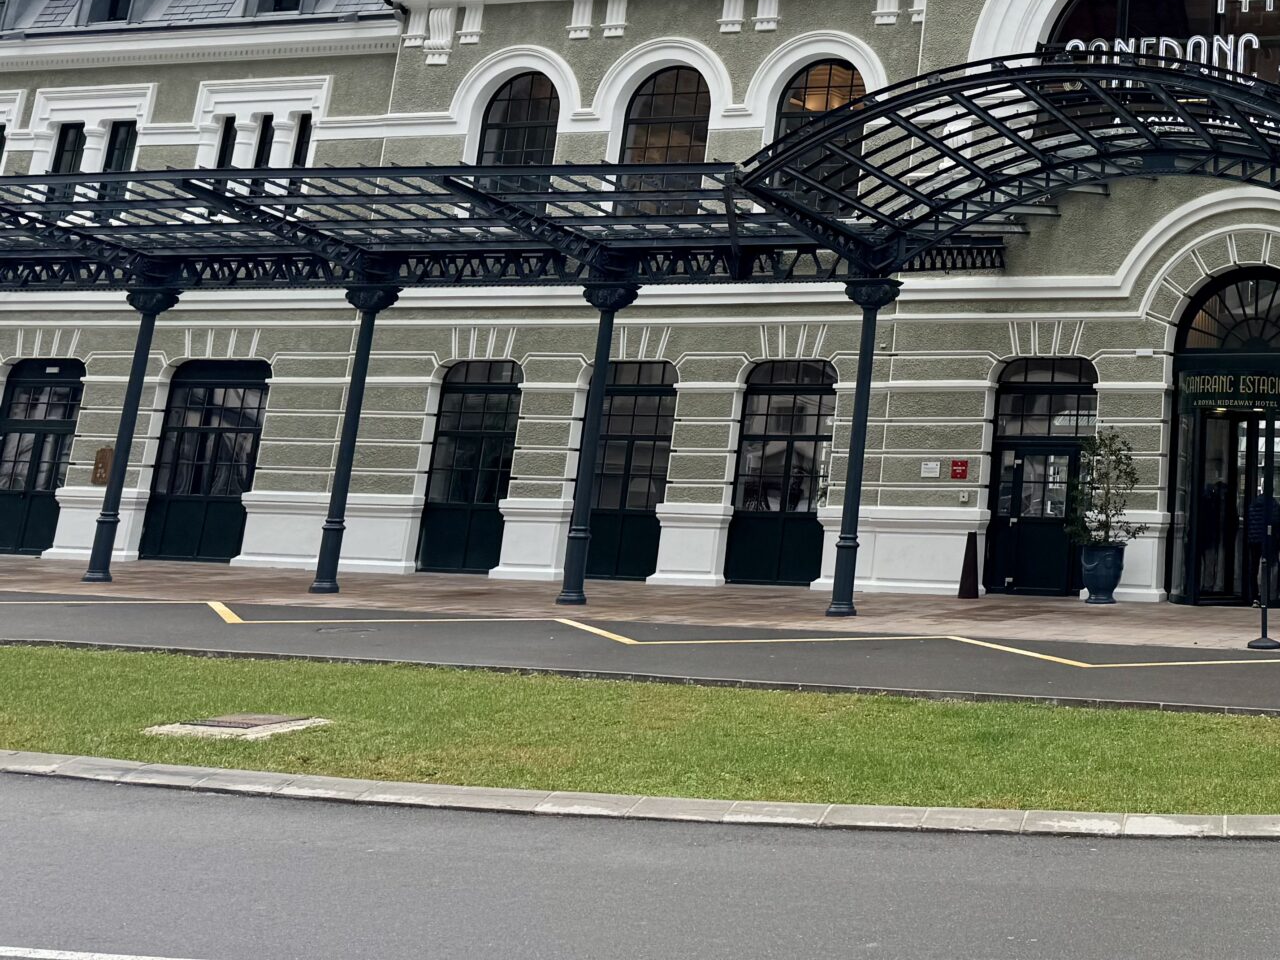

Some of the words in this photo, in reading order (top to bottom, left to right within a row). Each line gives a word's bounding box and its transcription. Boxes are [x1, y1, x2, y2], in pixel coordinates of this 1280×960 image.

[1185, 375, 1235, 394] CANFRANC
[1217, 399, 1253, 407] HIDEAWAY
[1255, 400, 1278, 408] HOTEL
